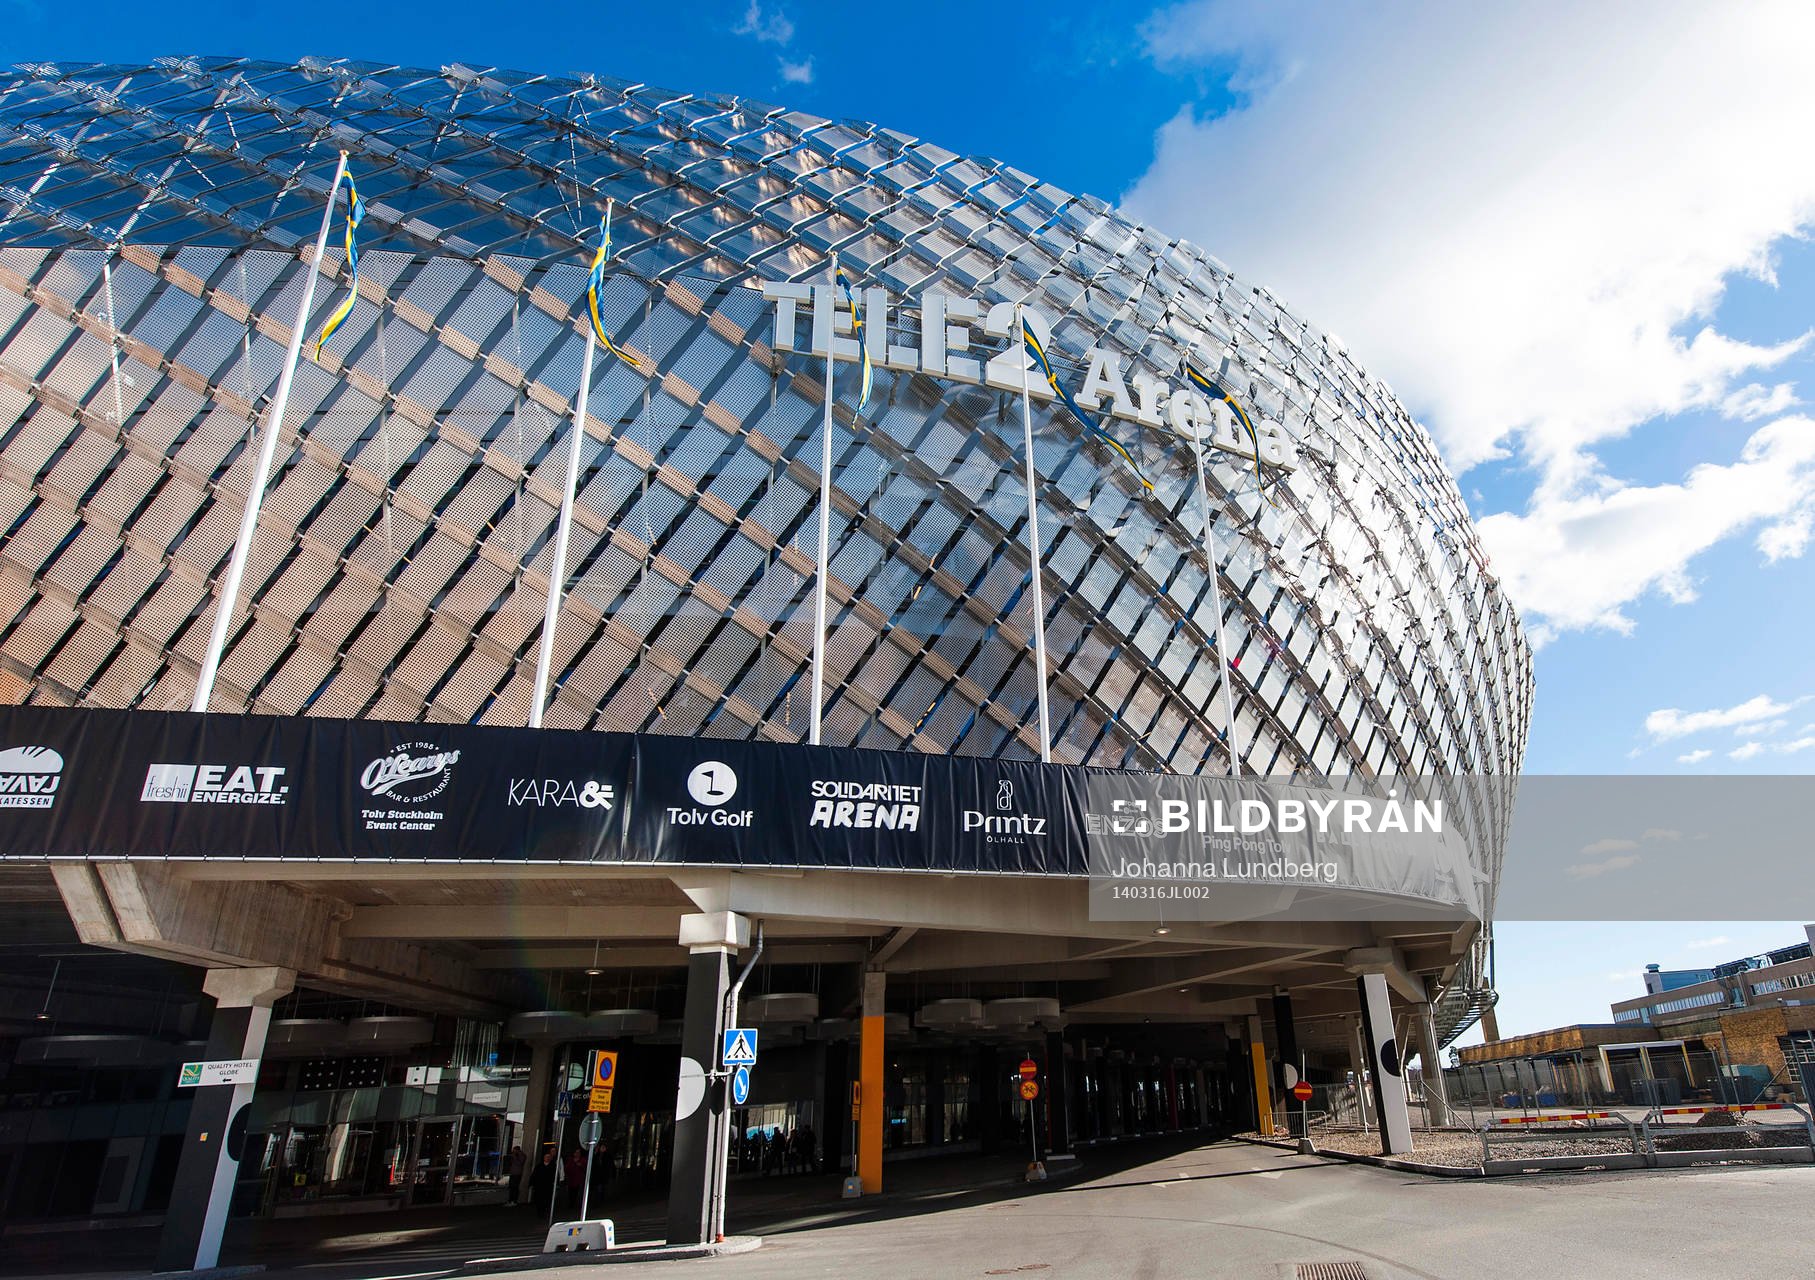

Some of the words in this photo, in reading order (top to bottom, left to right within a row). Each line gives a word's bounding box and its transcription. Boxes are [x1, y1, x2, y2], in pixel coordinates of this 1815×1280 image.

[763, 281, 1055, 400] TELE2
[1075, 348, 1299, 471] Arena
[395, 742, 412, 752] EST
[146, 775, 189, 799] freshii
[386, 789, 401, 802] BAR
[412, 767, 452, 803] RESTAURANT
[811, 780, 922, 803] SOLIDARITET
[0, 796, 50, 805] ATESSEN
[361, 809, 385, 819] Tolv
[387, 810, 444, 820] Stockholm
[667, 807, 709, 825] Tolv
[711, 809, 754, 827] Golf
[810, 800, 921, 832] ARENA
[963, 810, 1048, 836] Printz
[366, 821, 397, 830] Event
[400, 821, 436, 831] Center
[1203, 834, 1231, 851] Ping
[1233, 836, 1265, 854] Pong
